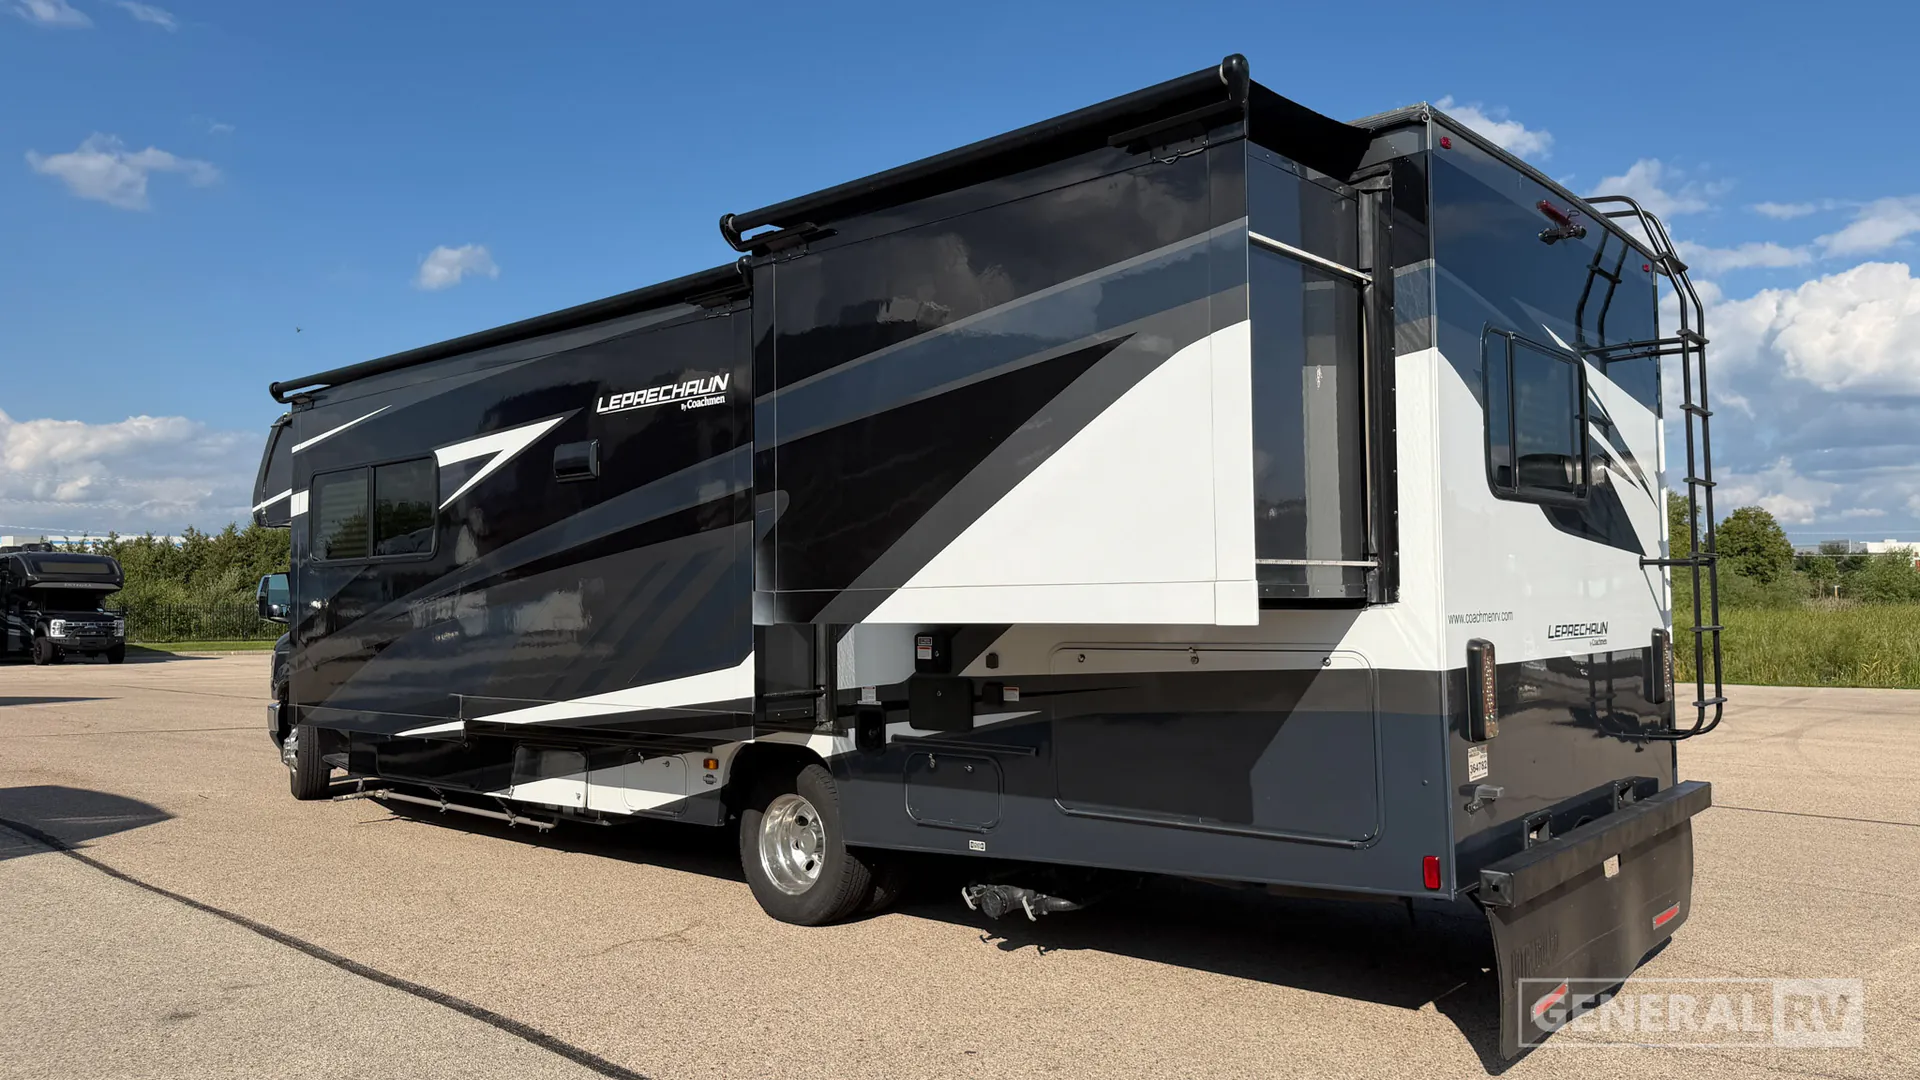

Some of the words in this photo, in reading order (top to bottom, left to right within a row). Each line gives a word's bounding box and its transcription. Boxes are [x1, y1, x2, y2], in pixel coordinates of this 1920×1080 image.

[596, 373, 729, 413] LEPRECHAUN
[686, 395, 725, 409] Coachmen
[1448, 610, 1513, 625] www.coachmenrv.com
[1548, 621, 1608, 639] LEPRECHAUN
